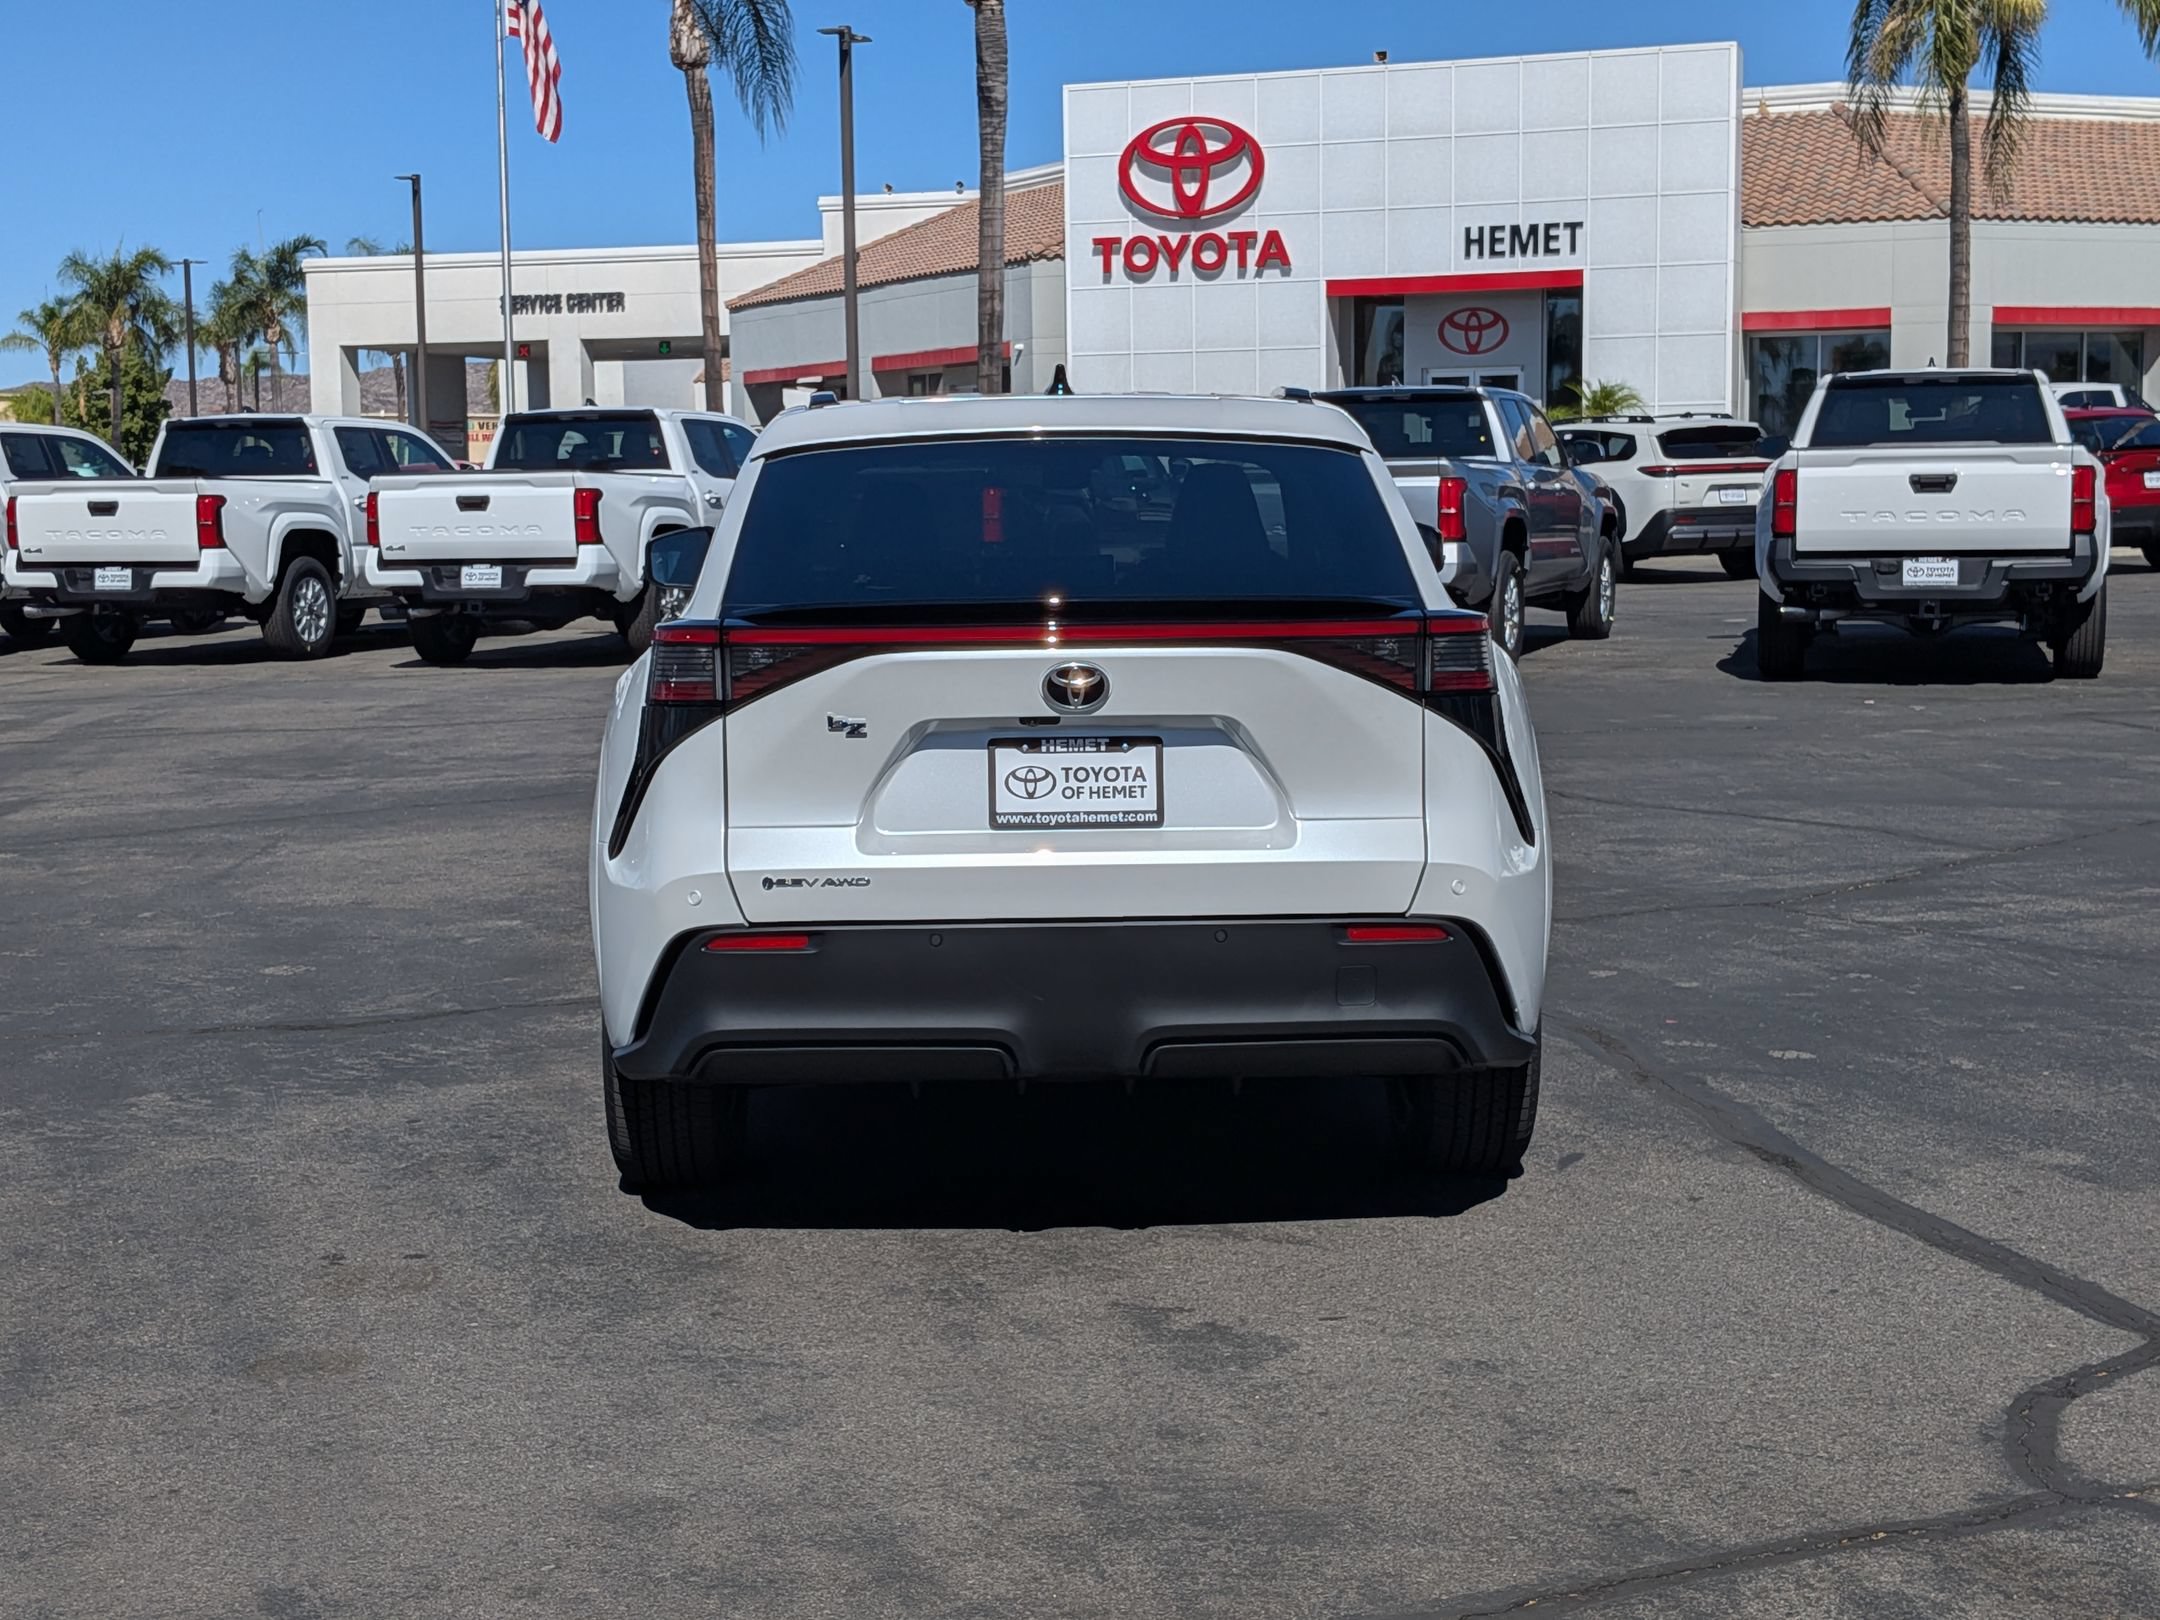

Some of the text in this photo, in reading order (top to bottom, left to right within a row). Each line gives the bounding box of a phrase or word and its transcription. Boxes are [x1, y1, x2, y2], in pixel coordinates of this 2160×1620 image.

[1464, 221, 1584, 260] HEMET
[1092, 230, 1292, 275] TOYOTA
[566, 292, 625, 314] CENTER
[1840, 509, 2026, 523] TACOMA
[45, 529, 167, 540] TACOMA
[408, 525, 543, 536] TACOMA
[1040, 738, 1110, 752] HEMET
[1061, 766, 1147, 783] TOYOTA
[1061, 785, 1148, 799] OF HEMET
[996, 811, 1158, 826] www.toyotahemet.com
[820, 877, 871, 887] AWD
